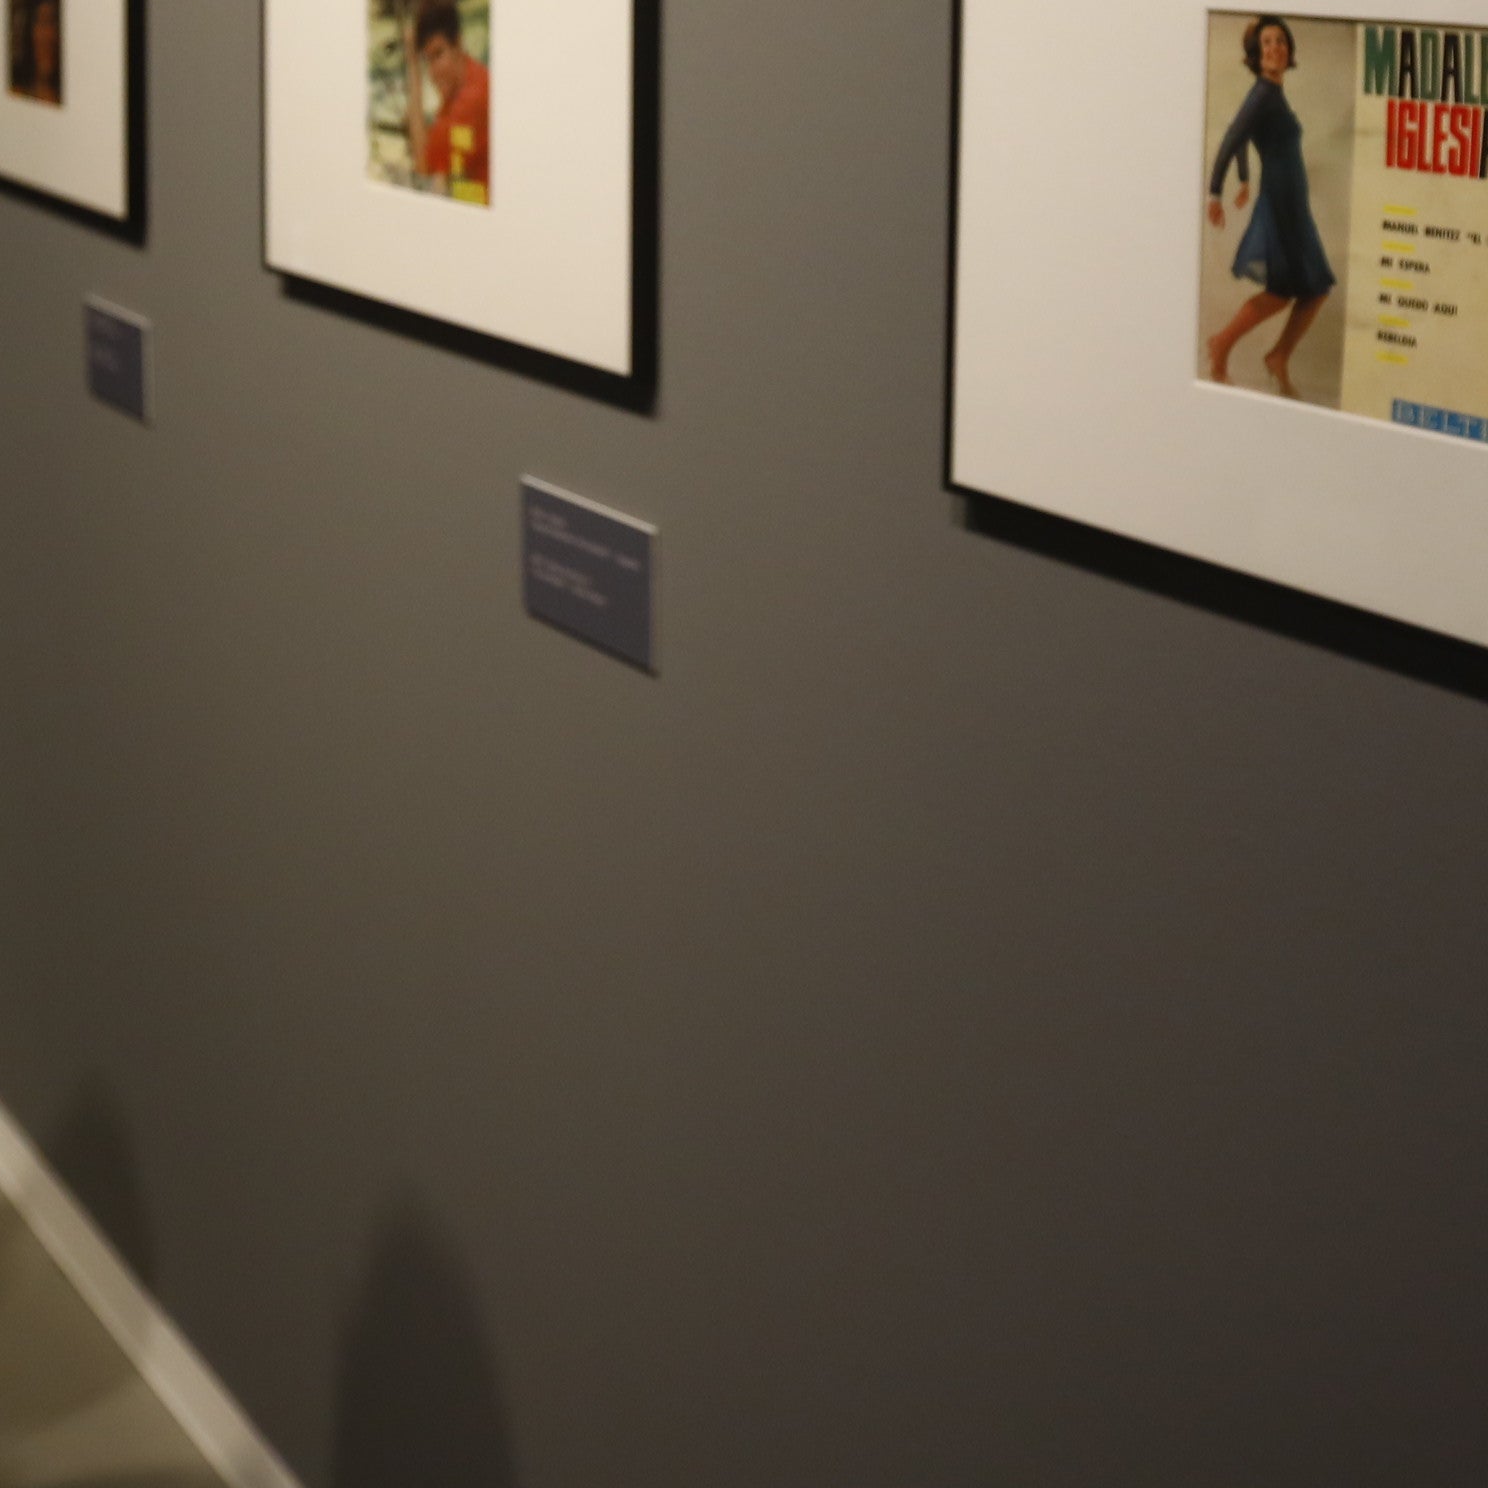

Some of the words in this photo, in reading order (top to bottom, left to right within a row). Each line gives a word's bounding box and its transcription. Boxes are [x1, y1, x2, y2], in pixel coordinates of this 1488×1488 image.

[1382, 219, 1418, 235] MANUEL
[1424, 226, 1460, 242] BENITEZ
[1398, 258, 1430, 273] ESPERA
